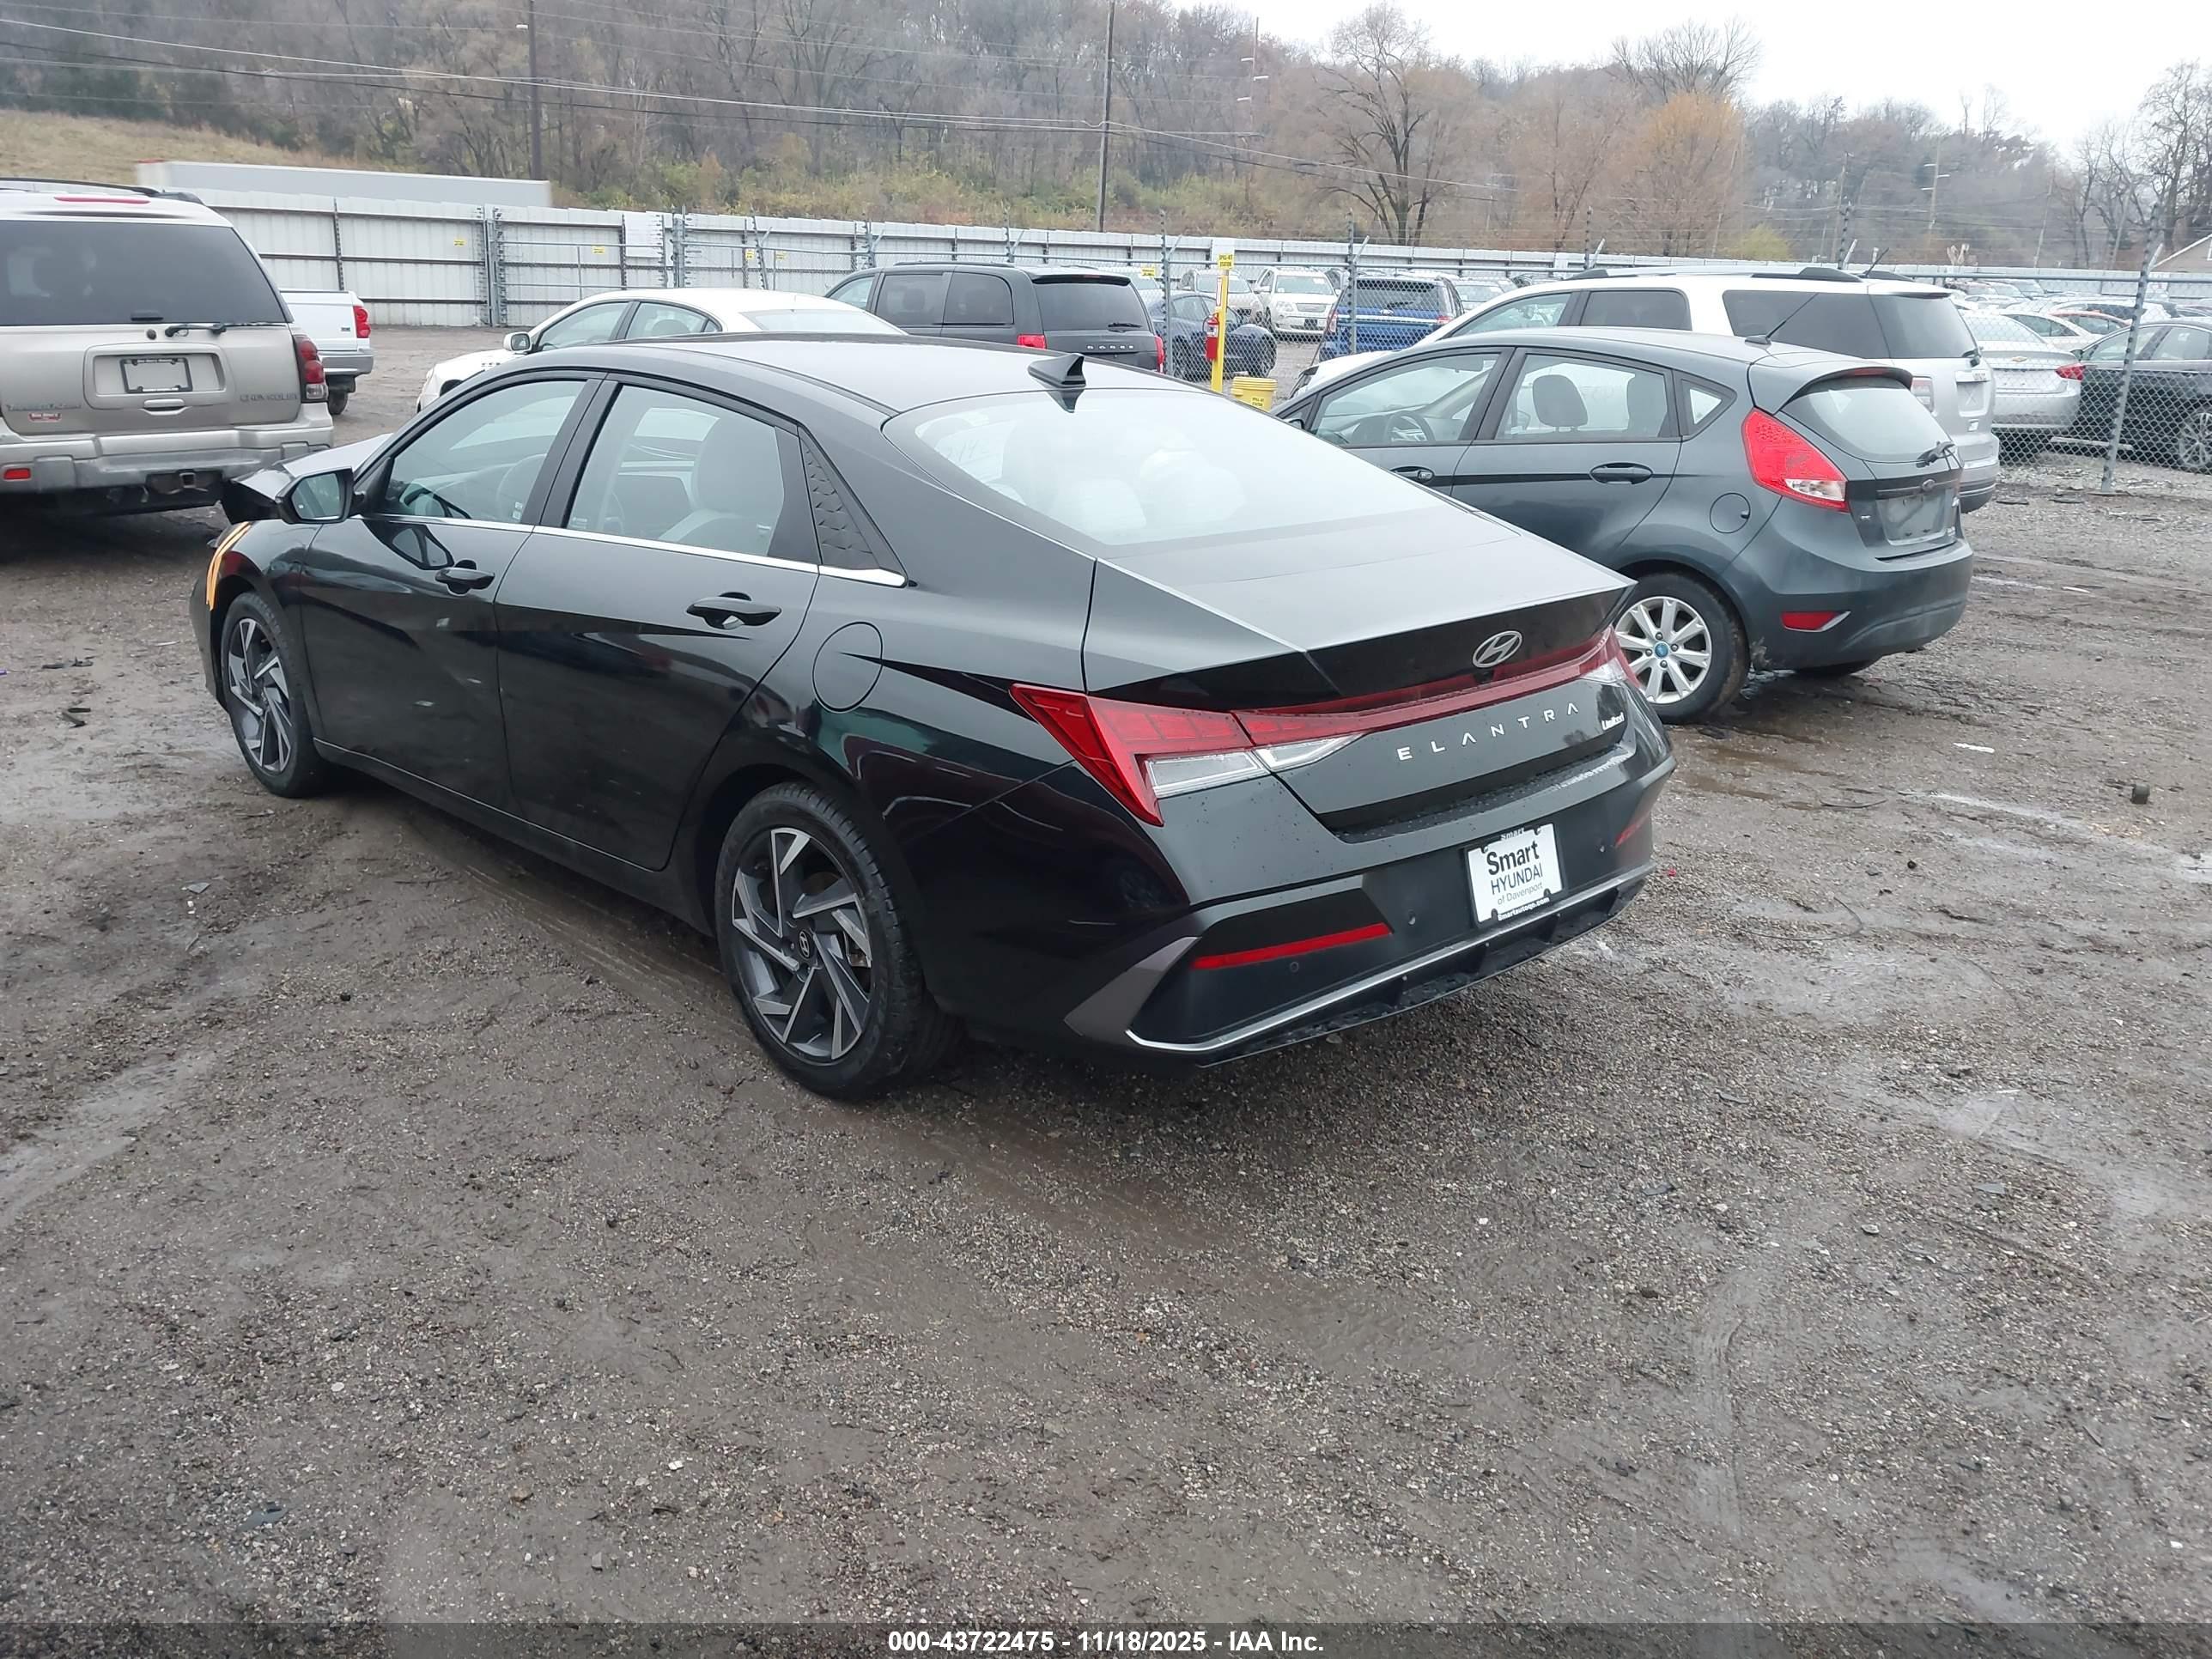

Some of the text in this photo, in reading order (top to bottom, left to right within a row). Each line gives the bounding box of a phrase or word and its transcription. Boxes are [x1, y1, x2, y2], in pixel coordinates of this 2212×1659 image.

[1396, 702, 1580, 762] ELANTRA
[1486, 841, 1540, 876] Smart
[1491, 862, 1543, 895] HYUNDAI
[1497, 882, 1543, 906] of Davenport
